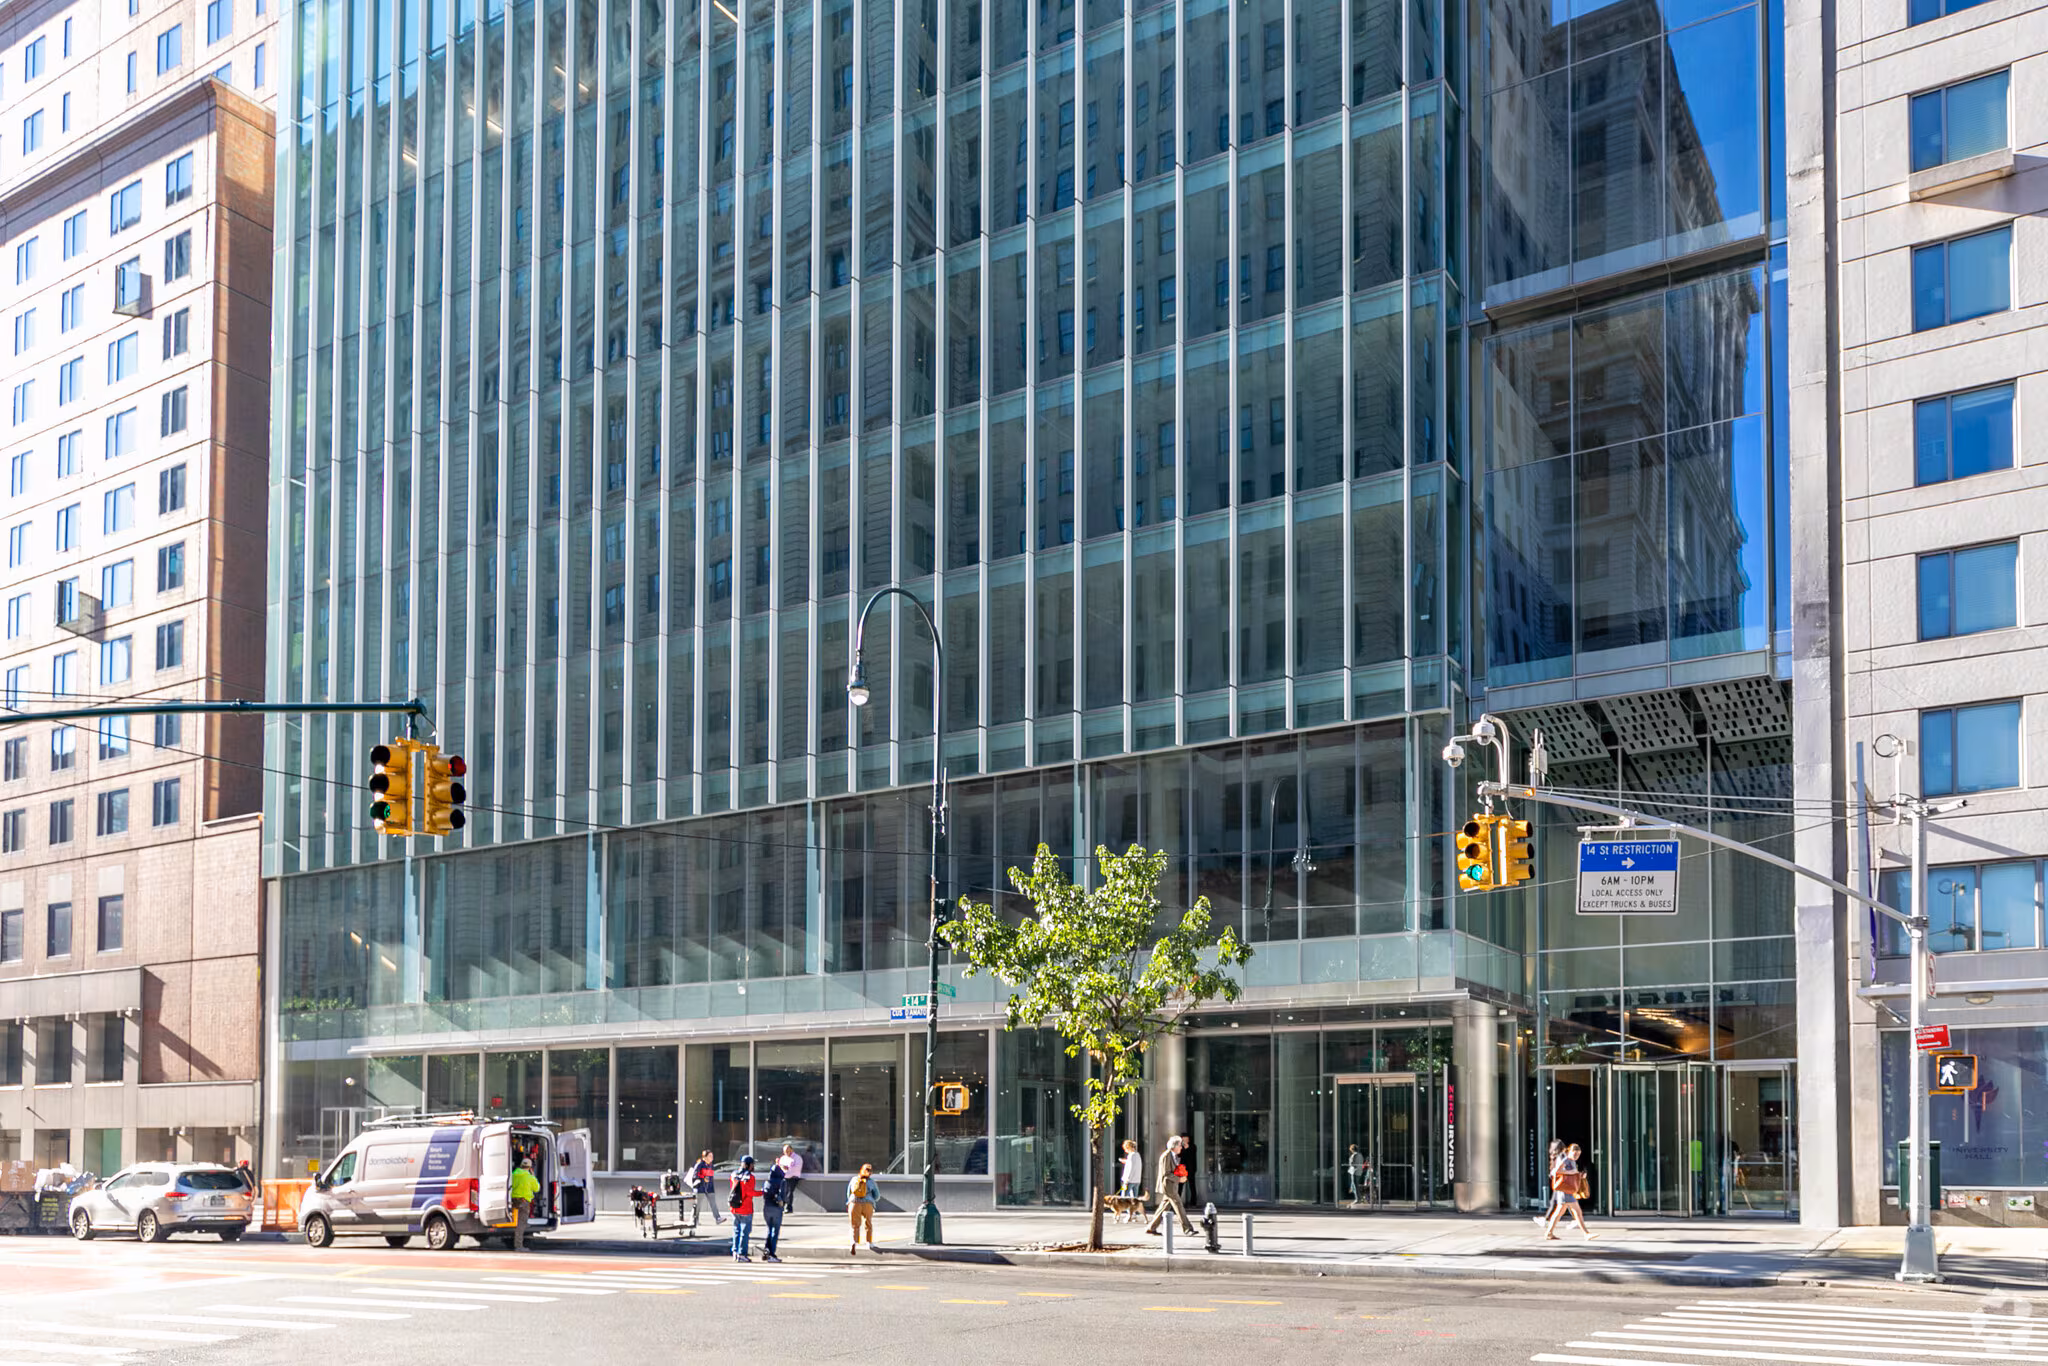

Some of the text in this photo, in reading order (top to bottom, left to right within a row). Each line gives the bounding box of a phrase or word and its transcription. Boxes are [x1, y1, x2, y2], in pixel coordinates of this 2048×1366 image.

[1587, 844, 1673, 855] 14 St RESTRICTION
[1601, 876, 1620, 885] 6AM
[1631, 875, 1655, 885] 10PM
[1591, 889, 1613, 897] LOCAL
[1616, 889, 1643, 897] ACCESS
[1582, 900, 1608, 908] EXCEPT
[1611, 900, 1638, 908] TRUCKS
